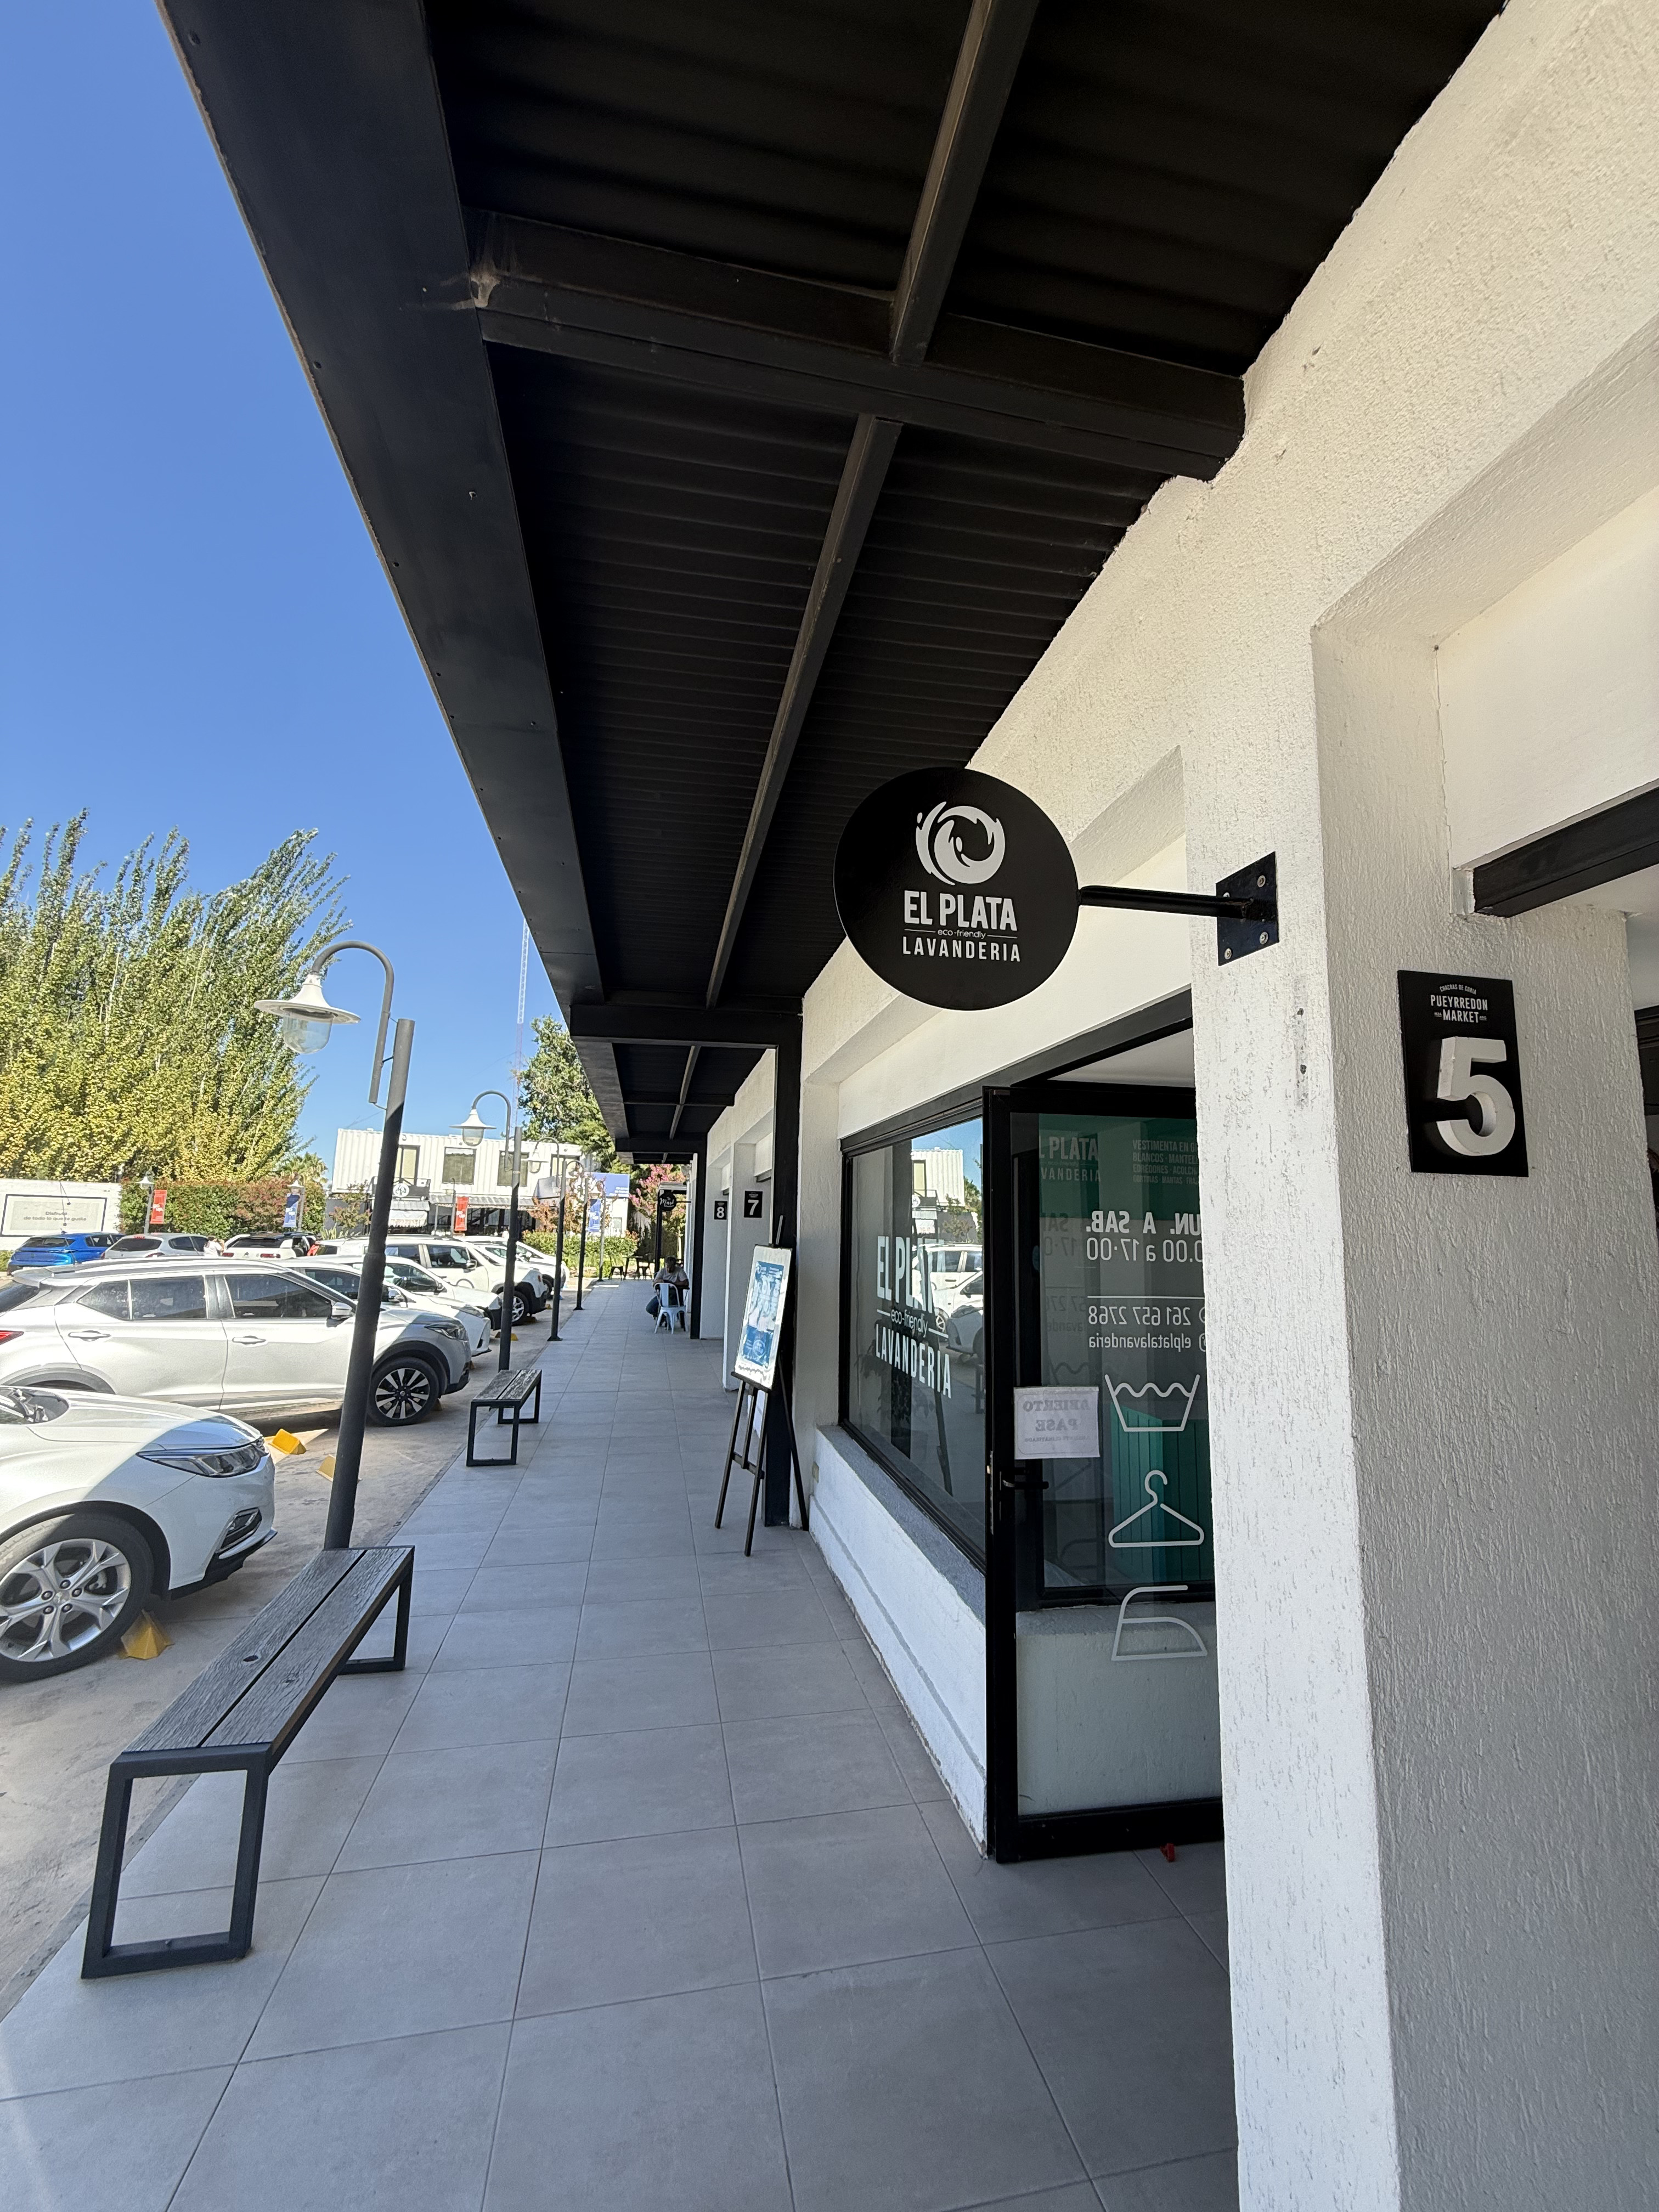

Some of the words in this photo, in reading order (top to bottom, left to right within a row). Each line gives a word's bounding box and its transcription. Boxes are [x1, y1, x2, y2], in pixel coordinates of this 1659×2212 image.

[905, 890, 933, 926] EL
[939, 893, 1018, 932] PLATA
[937, 929, 986, 940] eco-friendly
[902, 936, 1020, 962] LAVANDERIA
[1430, 994, 1488, 1011] PUEYRREDON
[1442, 1009, 1480, 1023] MARKET
[1436, 1036, 1516, 1156] 5
[1049, 1136, 1098, 1161] PLATA
[1132, 1139, 1178, 1152] VESTIMENTA
[1132, 1152, 1164, 1163] BLANCOS
[716, 1206, 725, 1218] 8
[748, 1199, 759, 1216] 7
[877, 1235, 892, 1301] EL
[890, 1309, 928, 1338] eco-friendly
[876, 1323, 951, 1399] LAVANDERIA
